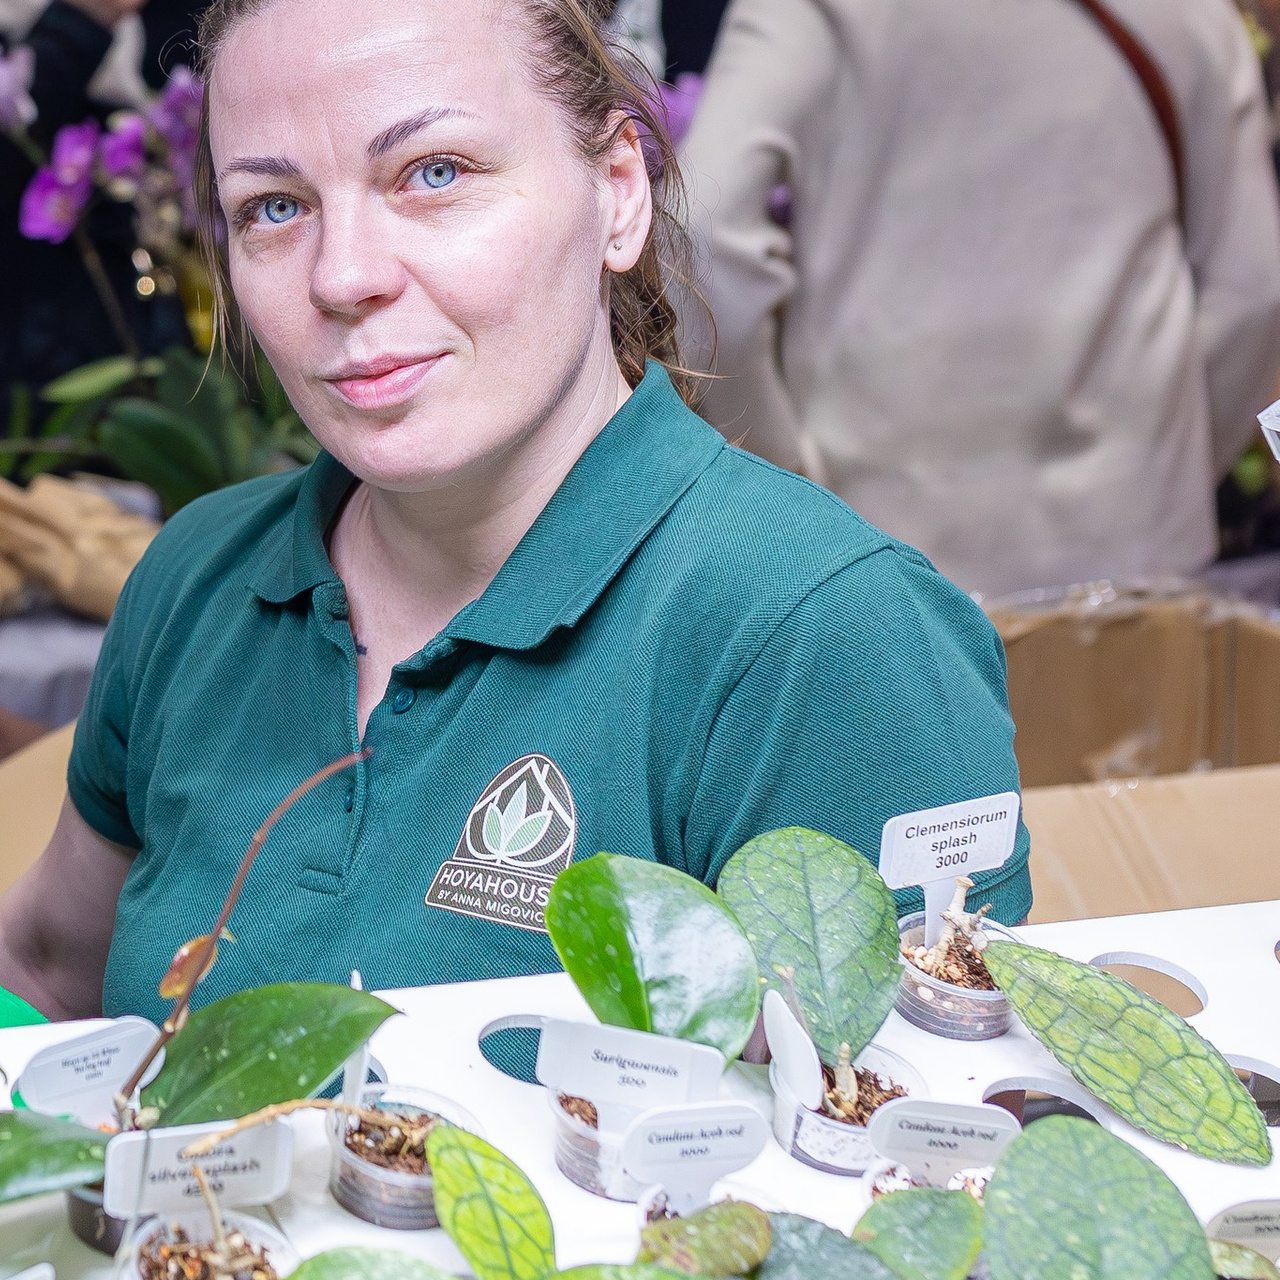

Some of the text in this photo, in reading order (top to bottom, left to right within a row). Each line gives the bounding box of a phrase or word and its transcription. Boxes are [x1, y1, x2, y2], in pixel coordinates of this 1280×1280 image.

[905, 810, 1008, 839] Clemensiorum
[931, 832, 977, 853] splash
[935, 851, 968, 869] 3000
[439, 868, 551, 907] HOYAHOUS
[437, 890, 546, 923] BY ANNA MIGOVIC
